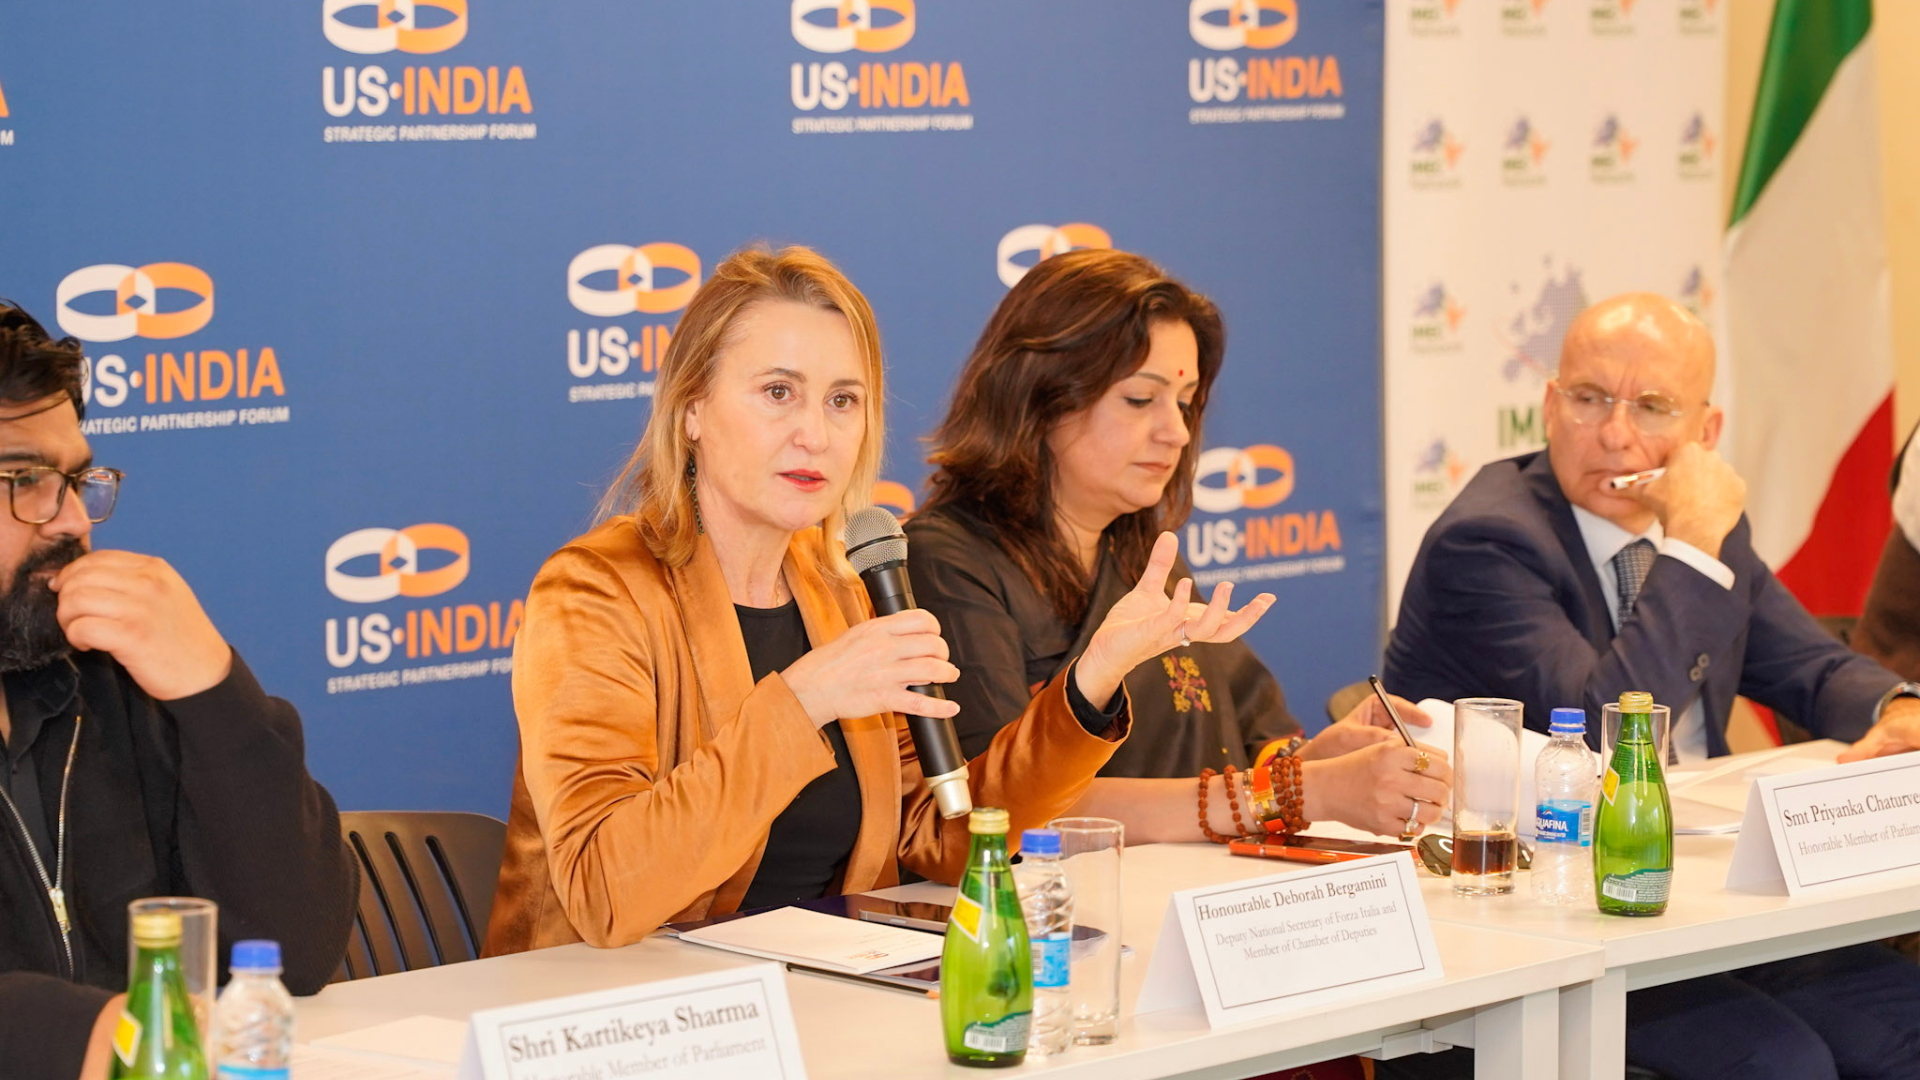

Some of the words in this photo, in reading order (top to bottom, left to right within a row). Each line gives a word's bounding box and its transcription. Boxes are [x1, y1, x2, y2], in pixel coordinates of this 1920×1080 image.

[324, 126, 397, 142] STRATEGIC
[399, 124, 488, 141] PARTNERSHIP
[489, 123, 537, 140] FORUM
[80, 416, 137, 435] ATEGIC
[140, 410, 237, 431] PARTNERSHIP
[239, 407, 289, 425] FORUM
[327, 670, 400, 694] STRATEGIC
[402, 659, 490, 685] PARTNERSHIP
[1536, 817, 1569, 832] QUAFINA
[1783, 809, 1810, 827] Smt
[1810, 799, 1864, 825] Priyanka
[1798, 836, 1843, 855] Honorable
[1844, 829, 1878, 847] Member
[1880, 825, 1890, 840] of
[1198, 894, 1271, 920] Honourable
[1273, 885, 1325, 906] Deborah
[1326, 873, 1387, 899] Bergamini
[1215, 931, 1247, 947] Deputy
[1249, 922, 1286, 939] National
[1286, 917, 1323, 932] Secretary
[1325, 913, 1334, 925] of
[1335, 911, 1359, 923] Forza
[1360, 905, 1381, 918] Italia
[1382, 901, 1397, 914] and
[1244, 944, 1279, 960] Member
[1281, 939, 1291, 952] of
[1292, 935, 1330, 950] Chamber
[1331, 930, 1341, 943] of
[1341, 925, 1377, 943] Deputies
[508, 1028, 557, 1063] Shri
[562, 1017, 671, 1052] Kartikeya
[674, 1002, 759, 1032] Sharma
[673, 1046, 690, 1067] of
[692, 1038, 766, 1063] Parliament
